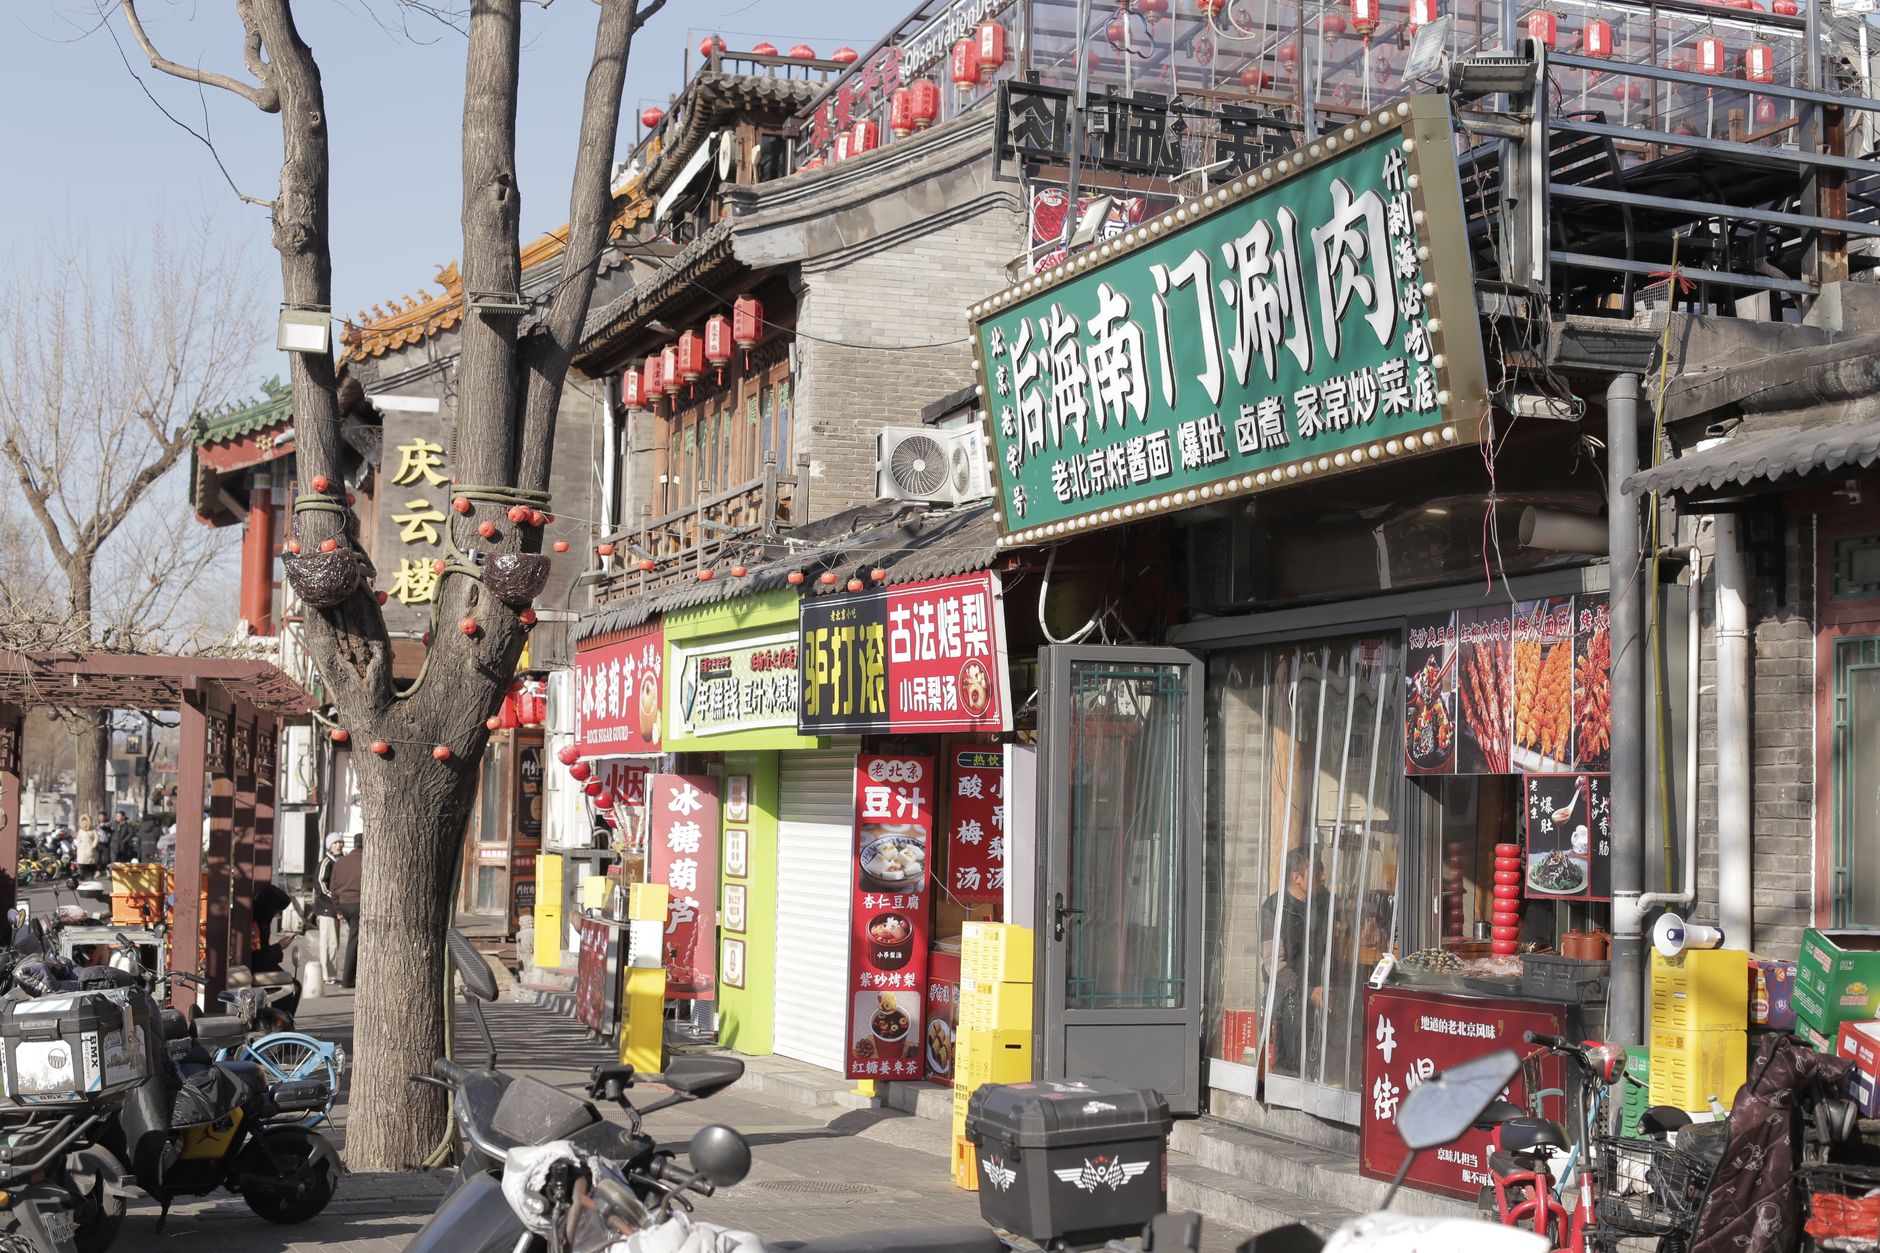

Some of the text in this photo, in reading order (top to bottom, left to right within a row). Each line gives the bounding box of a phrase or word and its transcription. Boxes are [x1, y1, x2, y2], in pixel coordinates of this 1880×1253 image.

[1381, 148, 1437, 414] 什刹海必吃店
[1008, 177, 1400, 464] 后海南门涮肉
[988, 326, 1028, 517] 北京老字号
[1050, 358, 1415, 504] 老北京炸酱面 爆肚 卤煮 家常炒菜
[387, 437, 450, 604] 庆云楼
[889, 592, 989, 663] 古法烤梨
[1408, 624, 1456, 650] 长沙臭豆腐
[582, 652, 636, 722] 冰糖葫芦
[805, 621, 886, 716] 驴打滚
[899, 675, 958, 713] 小吊梨汤
[605, 764, 650, 806] 烟
[871, 761, 920, 780] 老北京
[861, 785, 926, 819] 豆汁
[1528, 779, 1539, 820] 老北京
[1540, 796, 1555, 834] 爆肚
[955, 774, 985, 891] 酸梅汤
[665, 783, 703, 935] 冰糖葫芦
[862, 894, 920, 910] 杏仁豆腐
[859, 971, 917, 987] 紫砂烤梨
[1420, 1015, 1496, 1040] 地道的老北京风味
[90, 1035, 99, 1069] BMX
[851, 1059, 918, 1075] 红糖姜枣茶
[1373, 1013, 1400, 1125] 牛街
[1437, 1147, 1478, 1168] 京味儿担当
